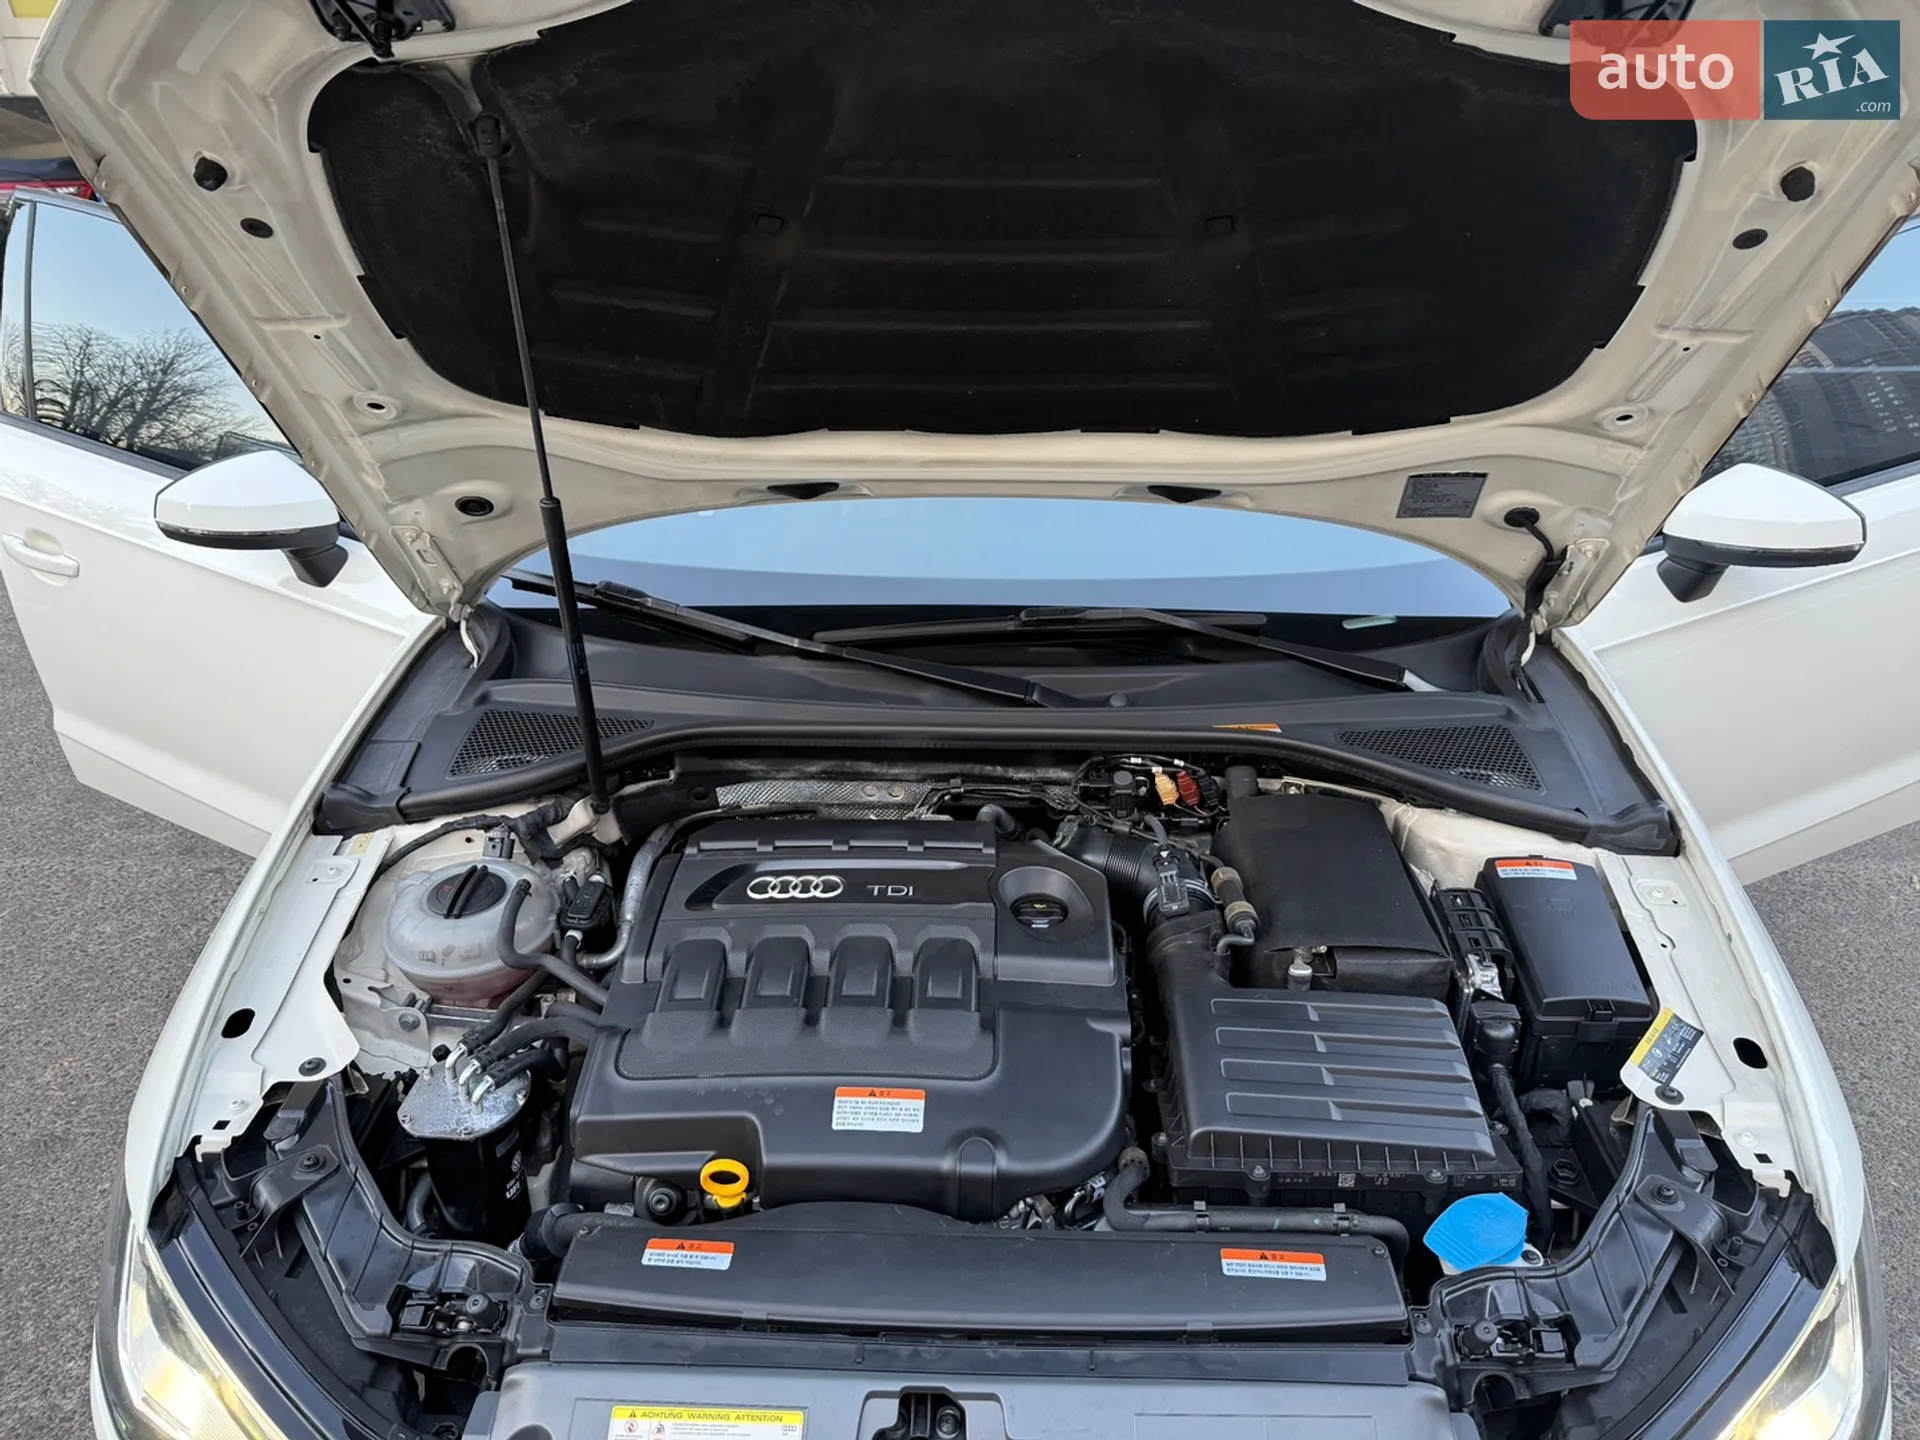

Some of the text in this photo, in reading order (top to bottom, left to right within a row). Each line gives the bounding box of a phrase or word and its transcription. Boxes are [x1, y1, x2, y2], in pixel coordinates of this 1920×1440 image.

[866, 885, 914, 896] TDI
[640, 1411, 783, 1422] ACHTUNG WARNING ATTENTION
